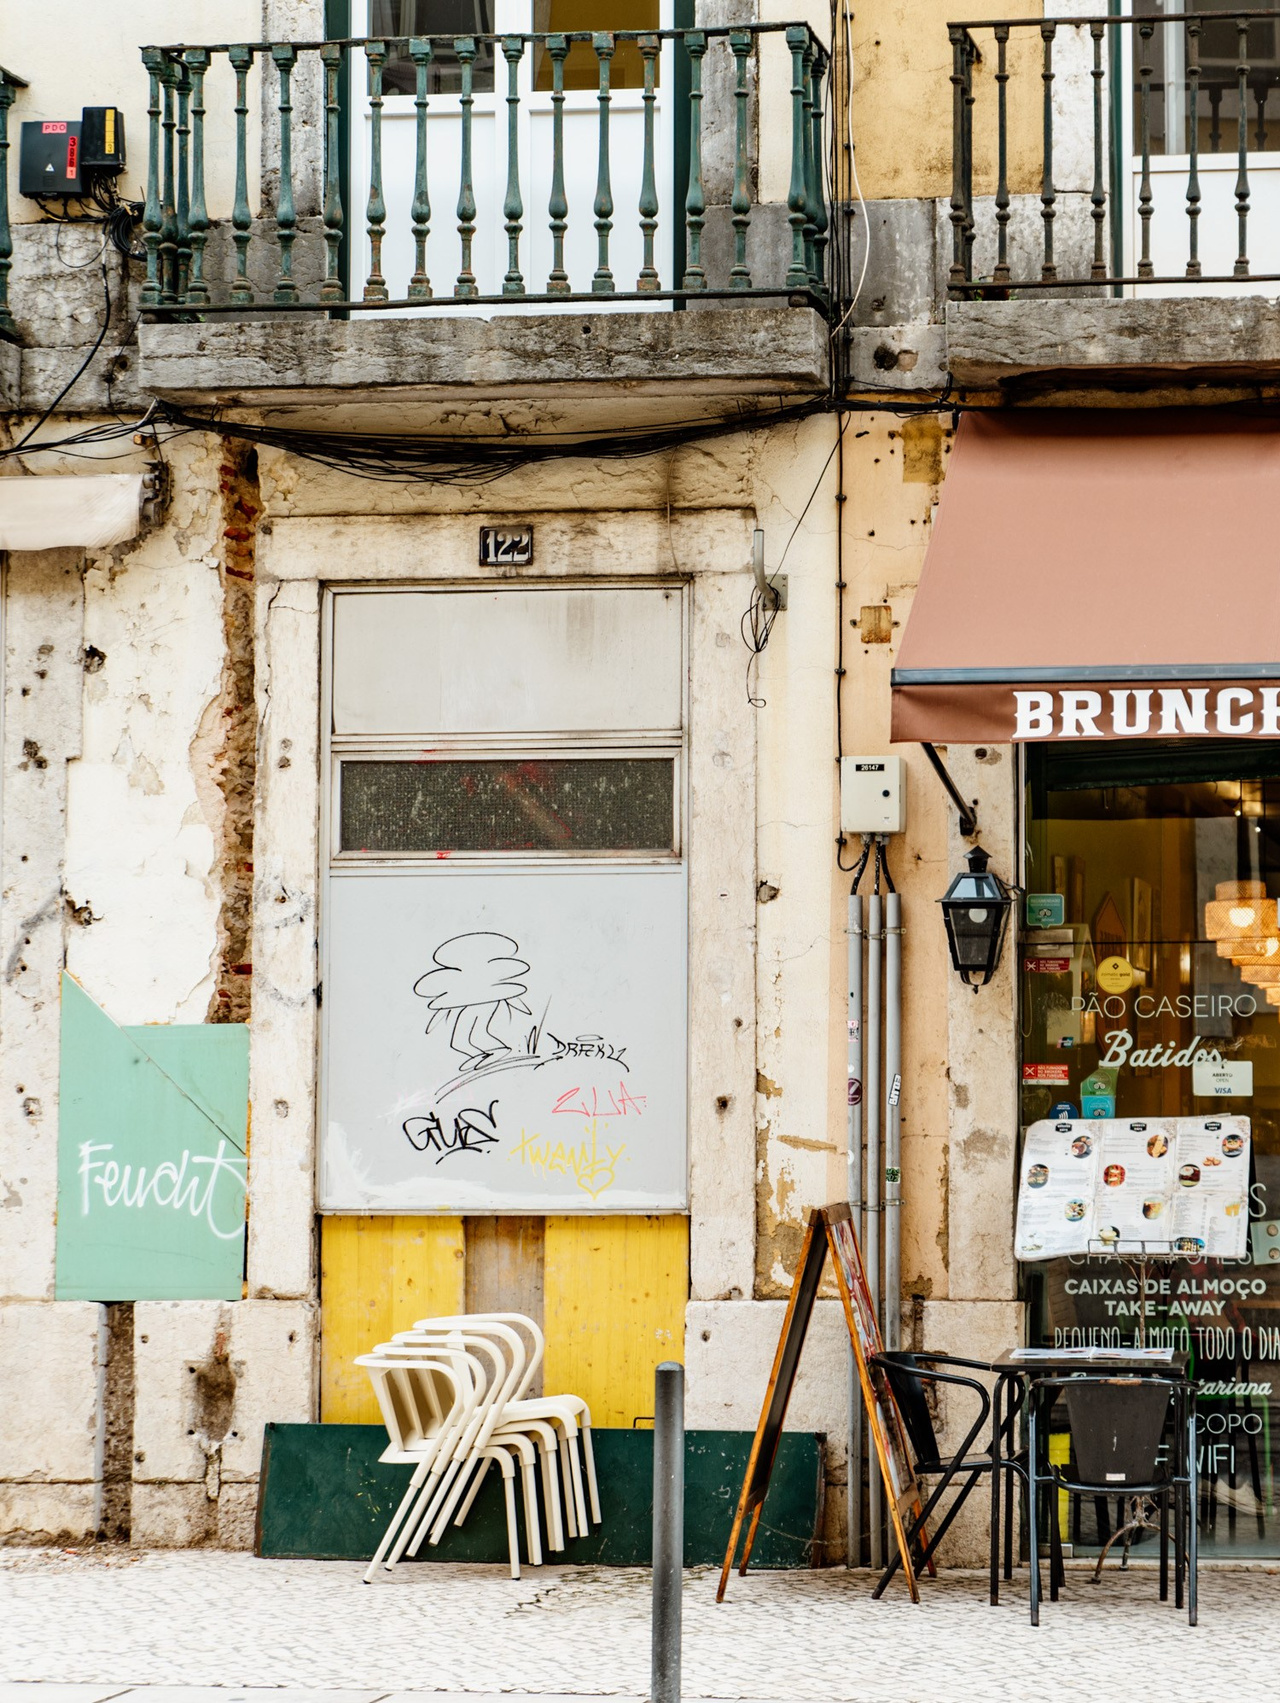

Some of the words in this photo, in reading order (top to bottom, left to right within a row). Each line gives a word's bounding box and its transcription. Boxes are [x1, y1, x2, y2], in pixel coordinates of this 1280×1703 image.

[486, 530, 529, 562] 122
[1071, 992, 1127, 1019] PÃO
[1134, 994, 1257, 1019] CASEIRO
[1098, 1028, 1226, 1068] Batidos
[1064, 1279, 1138, 1295] CAIXAS
[1144, 1279, 1171, 1295] DE
[1176, 1279, 1267, 1300] ALMOÇO
[1104, 1300, 1226, 1317] TAKE-AWAY
[1195, 1326, 1236, 1360] TODO
[1242, 1326, 1252, 1360] O
